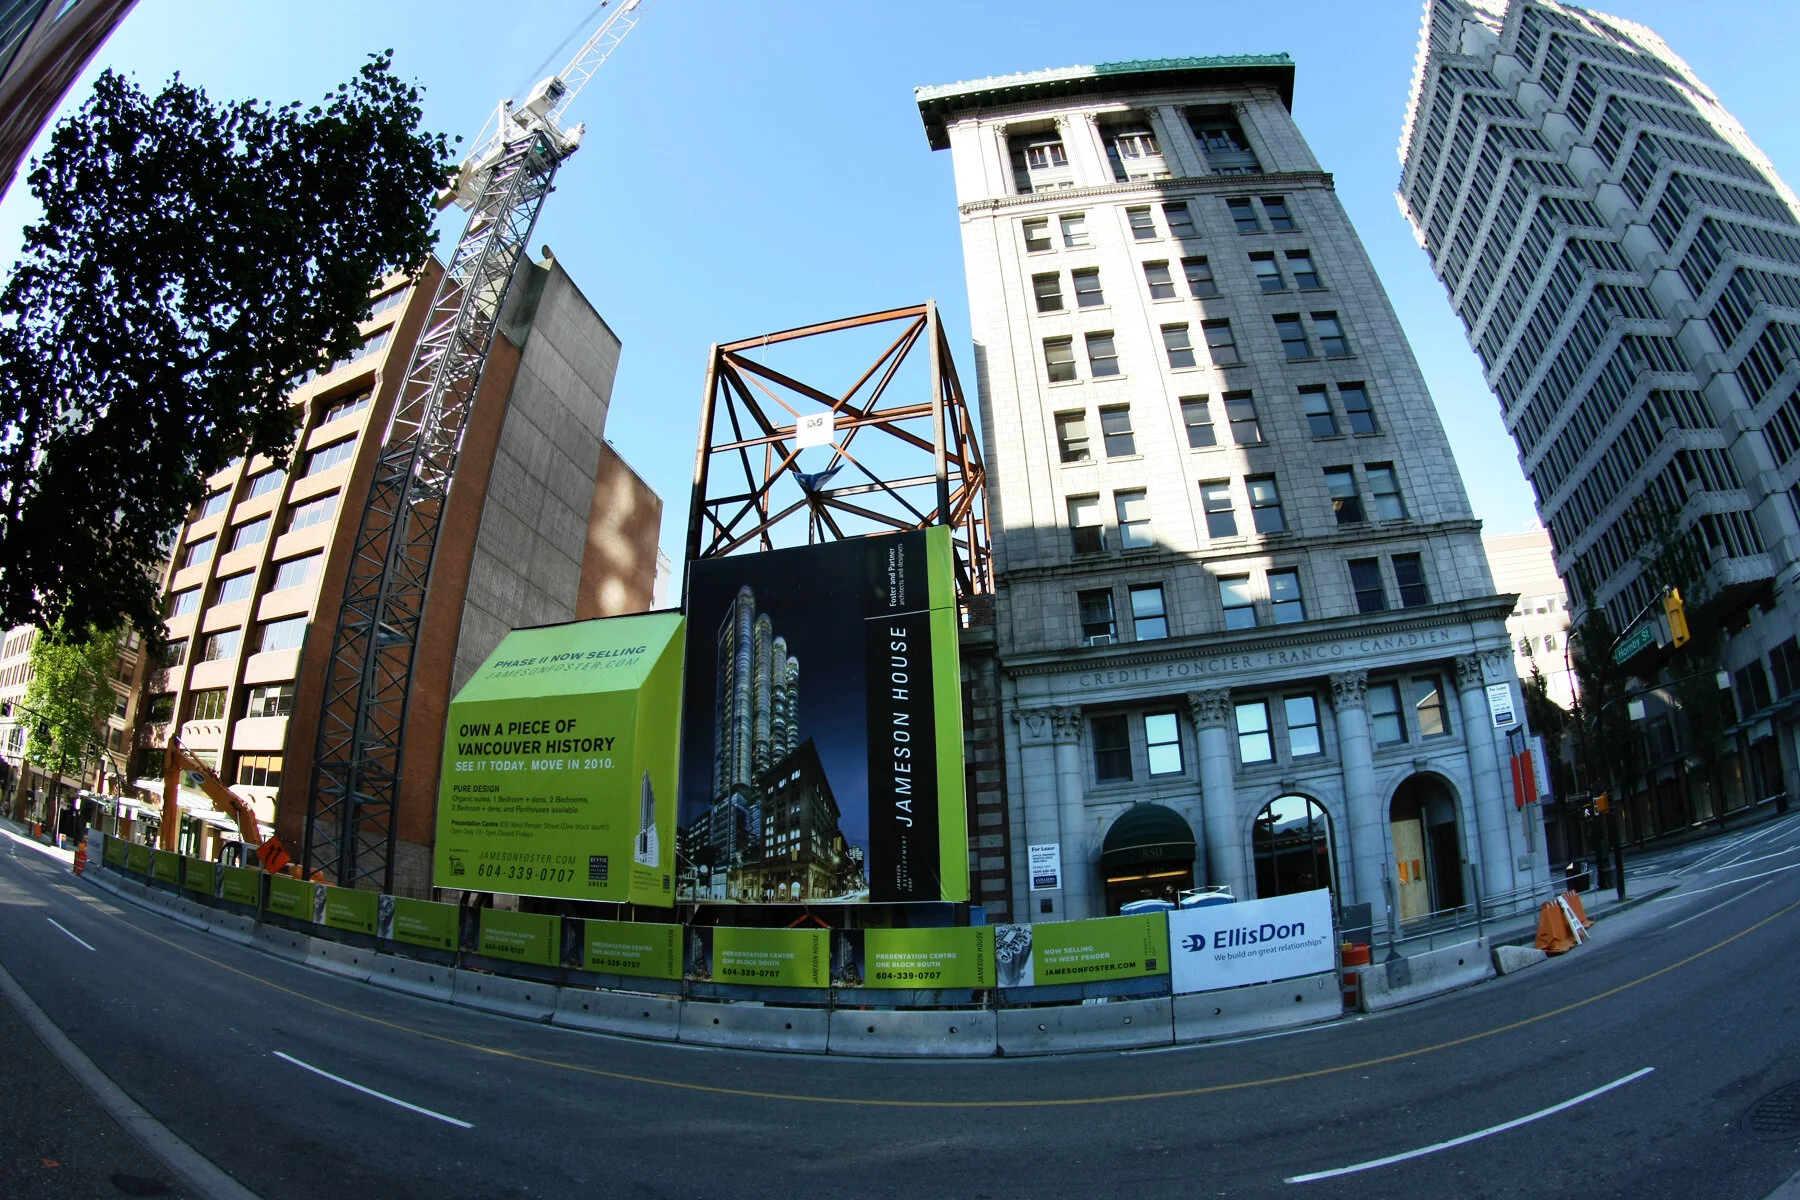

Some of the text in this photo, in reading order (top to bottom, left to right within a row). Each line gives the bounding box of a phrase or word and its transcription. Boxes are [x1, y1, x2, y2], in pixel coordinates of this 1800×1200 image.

[1618, 630, 1650, 659] Hornby St
[494, 646, 647, 668] PHASE II NOW SELLING
[1080, 629, 1450, 687] CREDIT FONCIER FRANCO CANADIEN
[484, 657, 640, 680] JAMESONFOSTER.COM
[460, 719, 577, 738] OWN A PIECE OF
[890, 626, 913, 828] JAMESON HOUSE
[458, 737, 616, 756] VANCOUVER HISTORY
[456, 758, 615, 772] SEE IT TODAY. MOVE IN 2010.
[474, 785, 500, 793] DESIGN
[556, 796, 588, 804] Bedrooms,
[478, 851, 576, 865] JAMESONFOSTER.COM
[1214, 922, 1305, 949] EllisDon
[592, 942, 630, 950] PRESENTATION
[1044, 945, 1094, 956] NOW SELLING
[1060, 954, 1079, 963] WEST
[1081, 952, 1110, 960] PENDER
[1214, 954, 1226, 962] We
[1227, 950, 1246, 960] build
[1258, 946, 1278, 957] great
[722, 968, 780, 978] 604-339-0707
[876, 971, 942, 980] 604-339-0707
[1045, 962, 1136, 976] JAMESONFOSTER.COM
